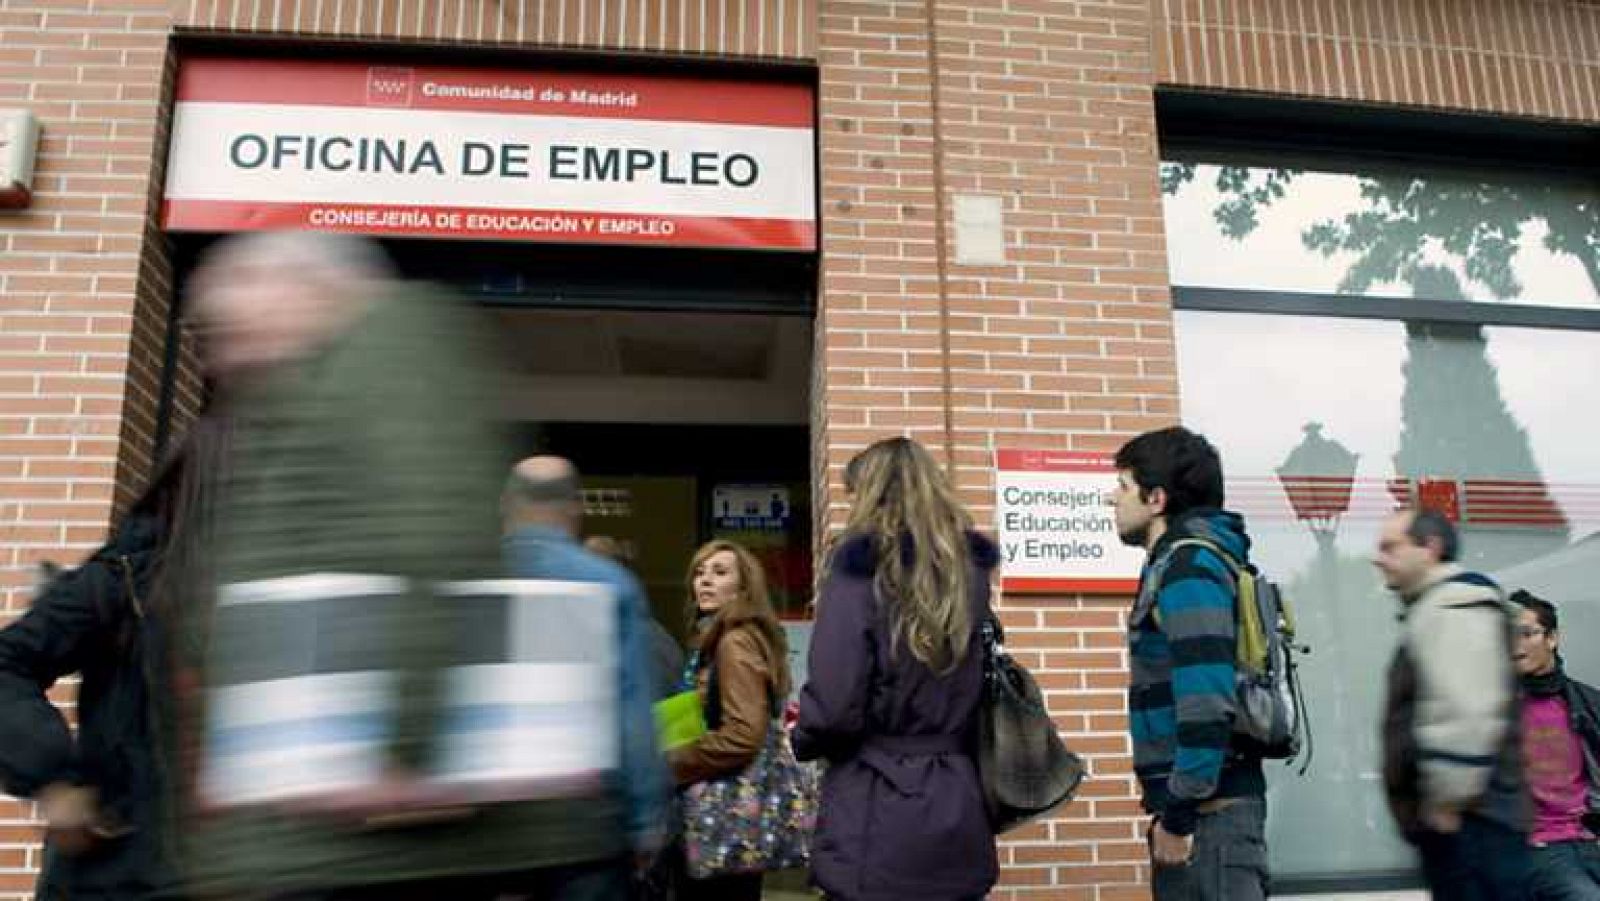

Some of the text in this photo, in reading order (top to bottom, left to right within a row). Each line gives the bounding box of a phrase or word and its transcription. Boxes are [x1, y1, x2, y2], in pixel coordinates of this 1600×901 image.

[422, 81, 638, 107] Comunidad de Madrid
[230, 133, 760, 187] OFICINA DE EMPLEO
[309, 207, 675, 235] CONSEJERÍA DE EDUCACIÓN Y EMPLEO
[1005, 540, 1103, 562] y Empleo
